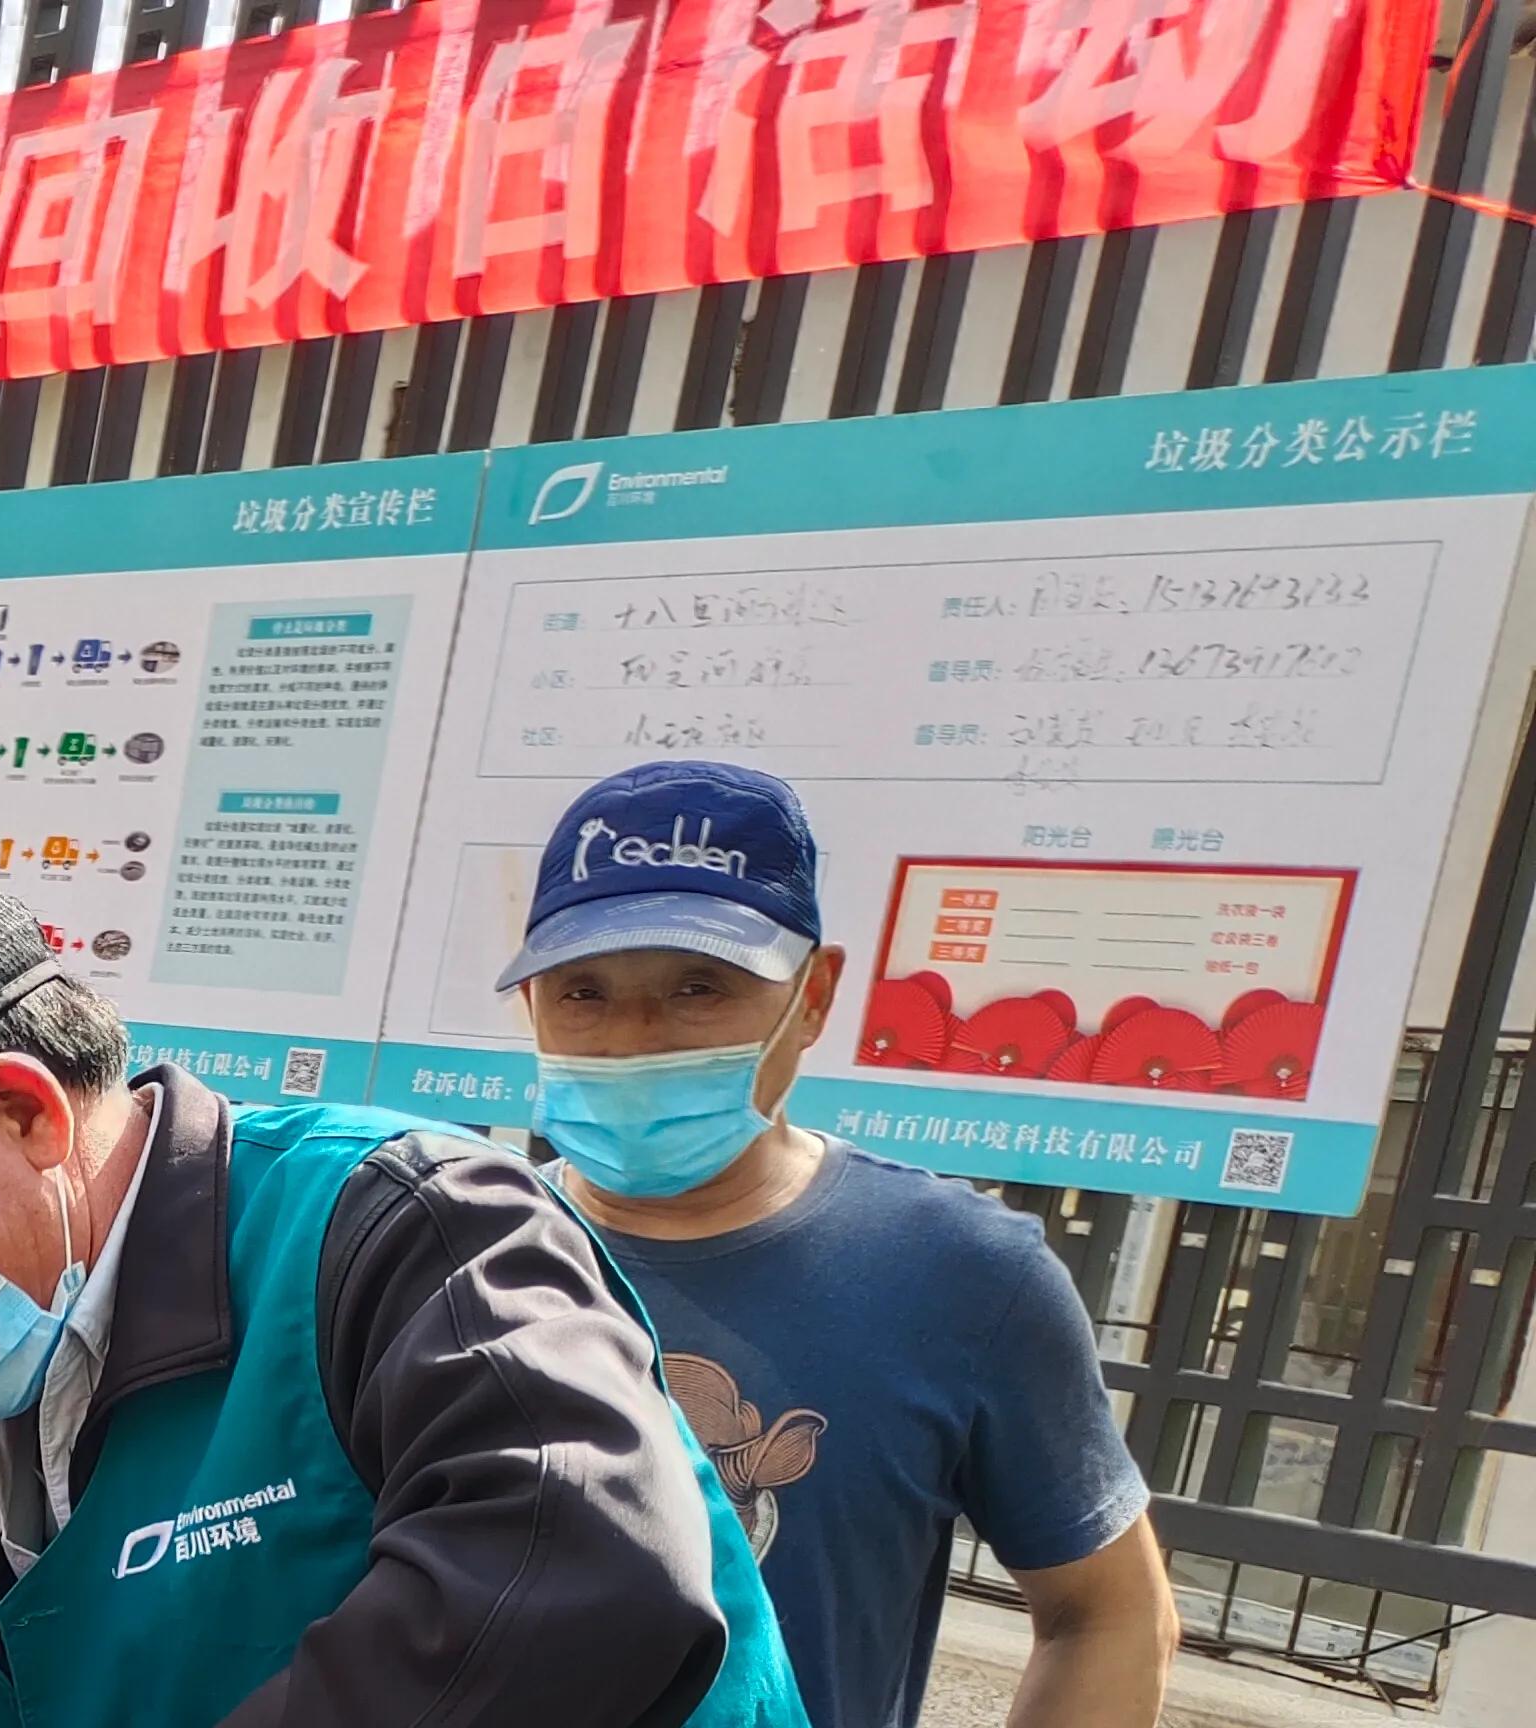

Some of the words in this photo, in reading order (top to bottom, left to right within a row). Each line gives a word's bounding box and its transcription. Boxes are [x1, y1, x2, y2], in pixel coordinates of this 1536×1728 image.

[1144, 409, 1476, 473] 垃圾分类公示栏
[608, 465, 727, 490] Environmental
[232, 488, 437, 534] 垃圾分类宣传栏
[1022, 824, 1093, 849] 阳光台
[412, 1068, 513, 1100] 投诉电话：
[836, 1108, 1204, 1171] 河南百川环境科技有限公司
[177, 1478, 298, 1531] Environmental
[174, 1516, 262, 1563] 百川环境
